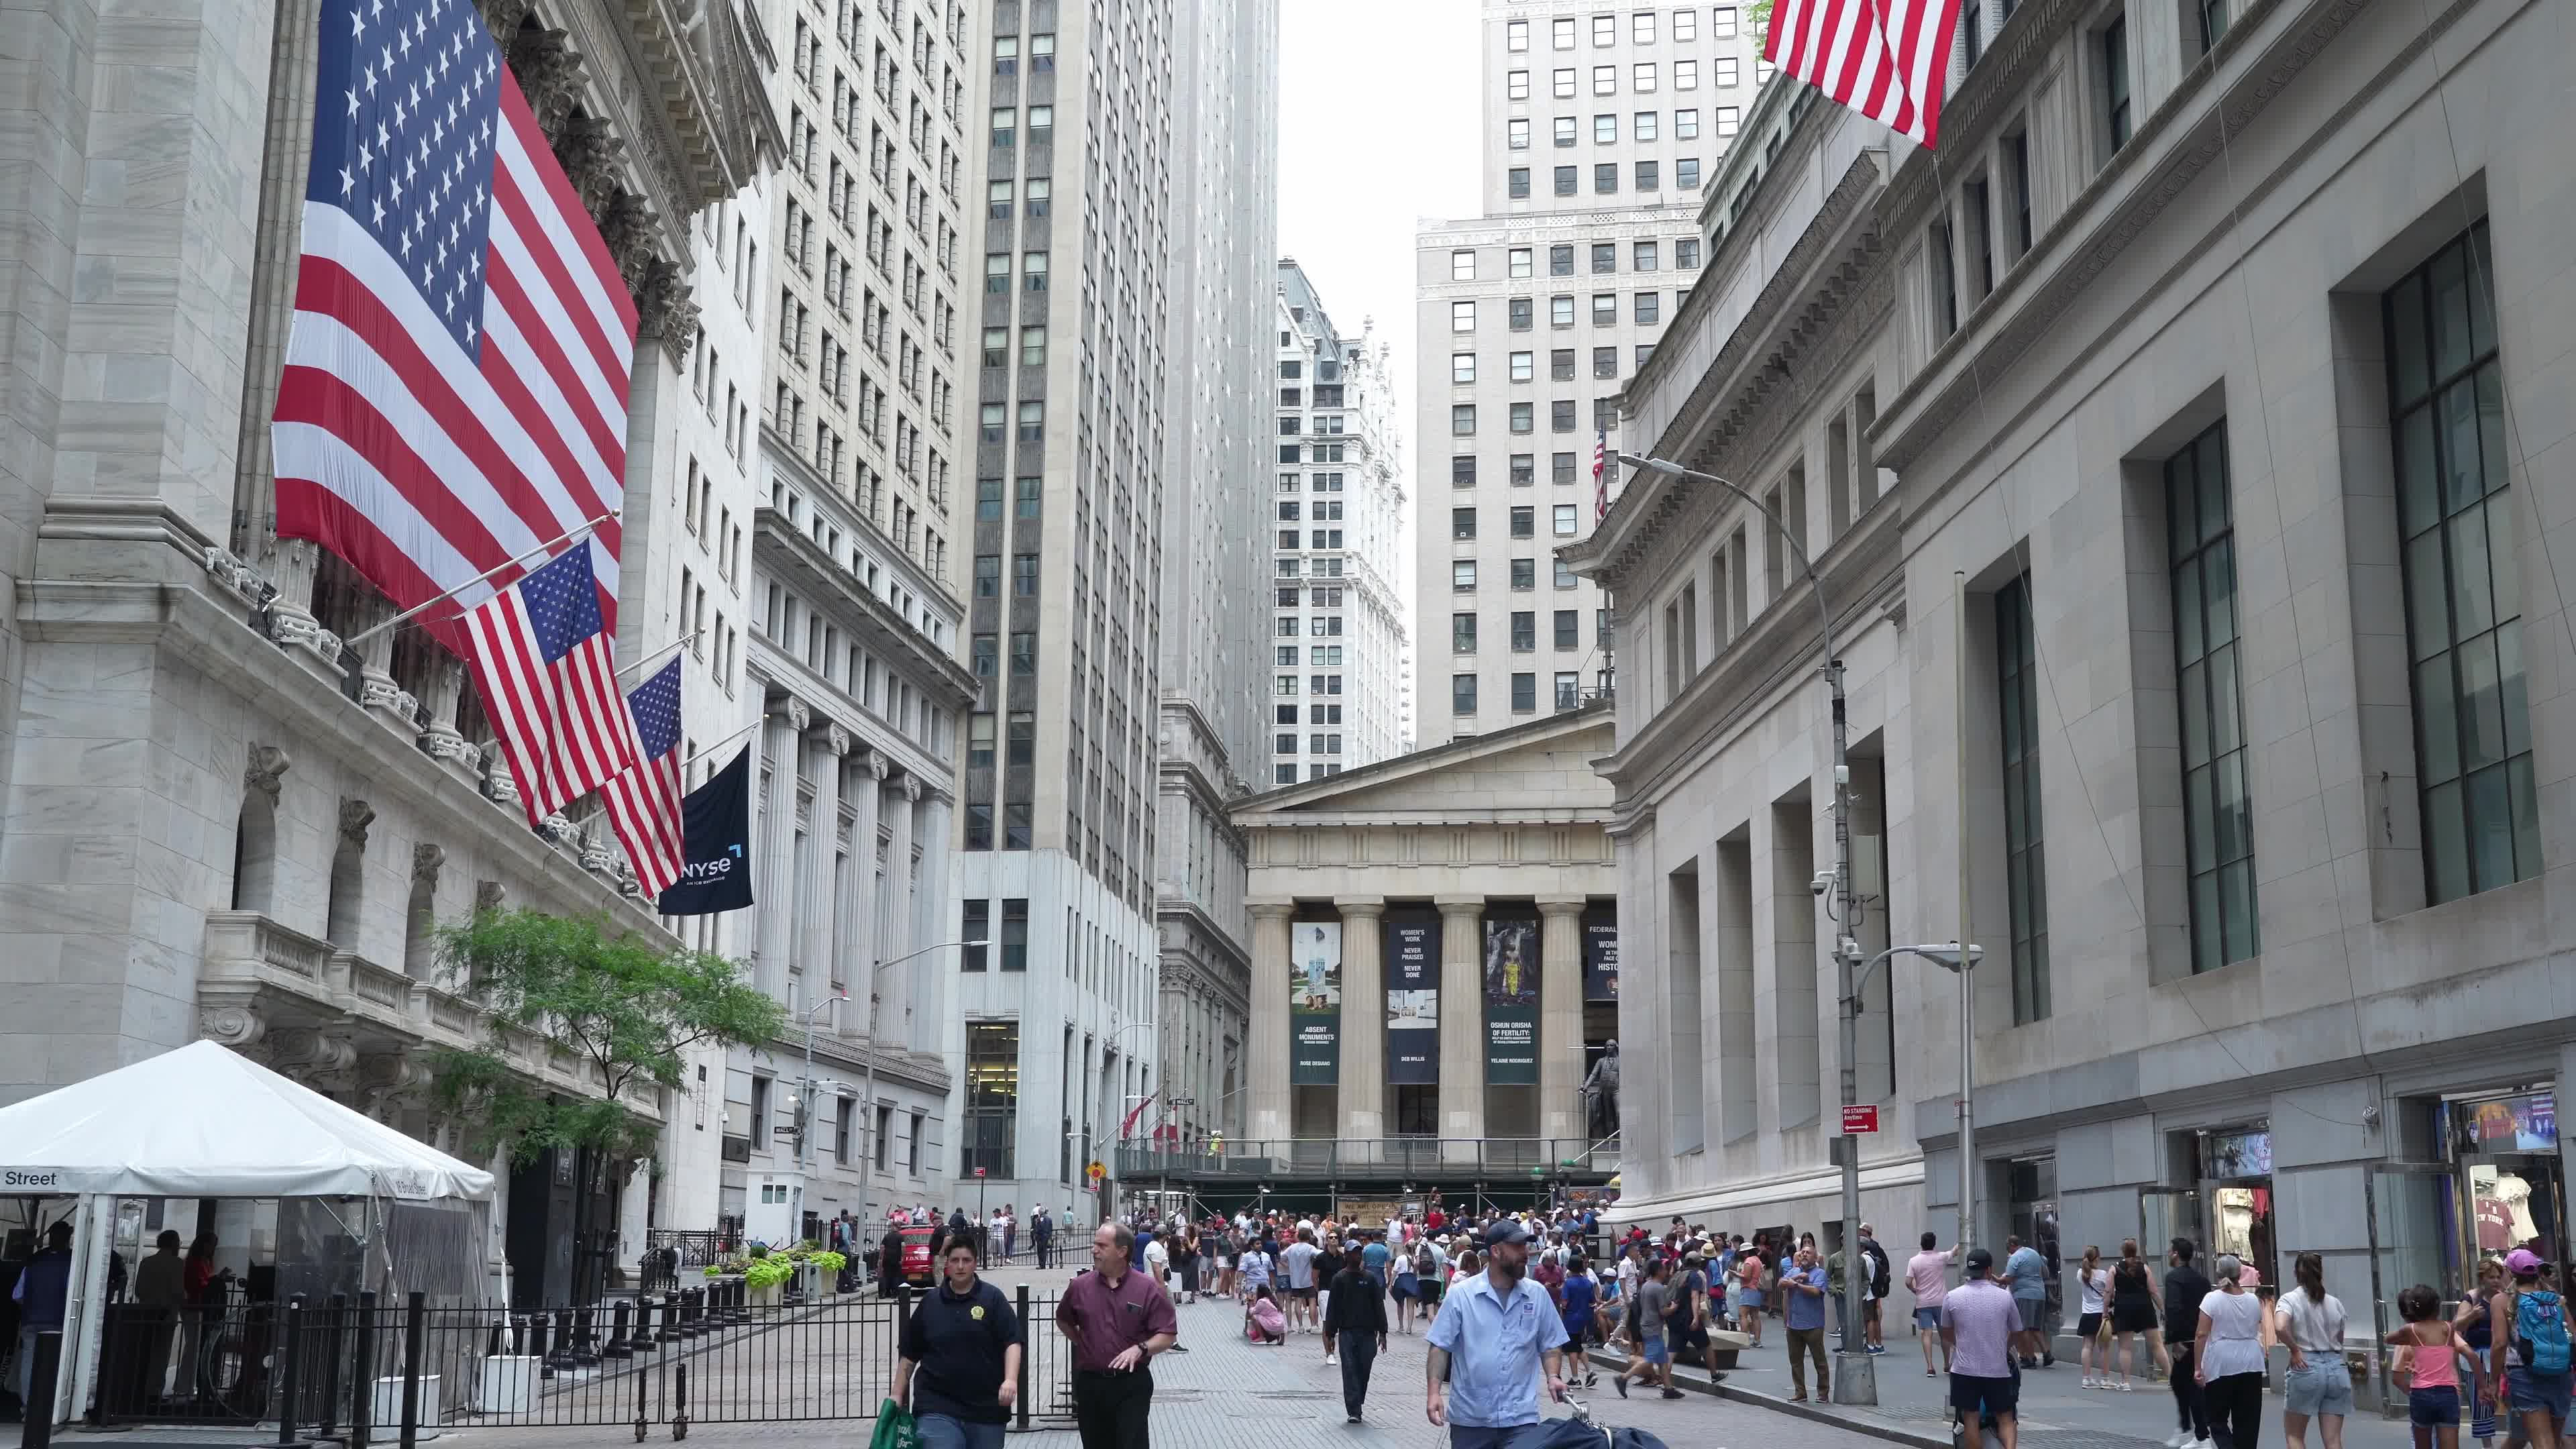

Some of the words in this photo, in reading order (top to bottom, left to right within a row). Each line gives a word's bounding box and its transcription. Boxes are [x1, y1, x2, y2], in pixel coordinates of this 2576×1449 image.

[1598, 940, 1617, 949] WOM
[1598, 963, 1619, 971] HISTO
[5, 1171, 57, 1185] Street
[2477, 1214, 2486, 1222] EW
[2487, 1214, 2504, 1226] YORK
